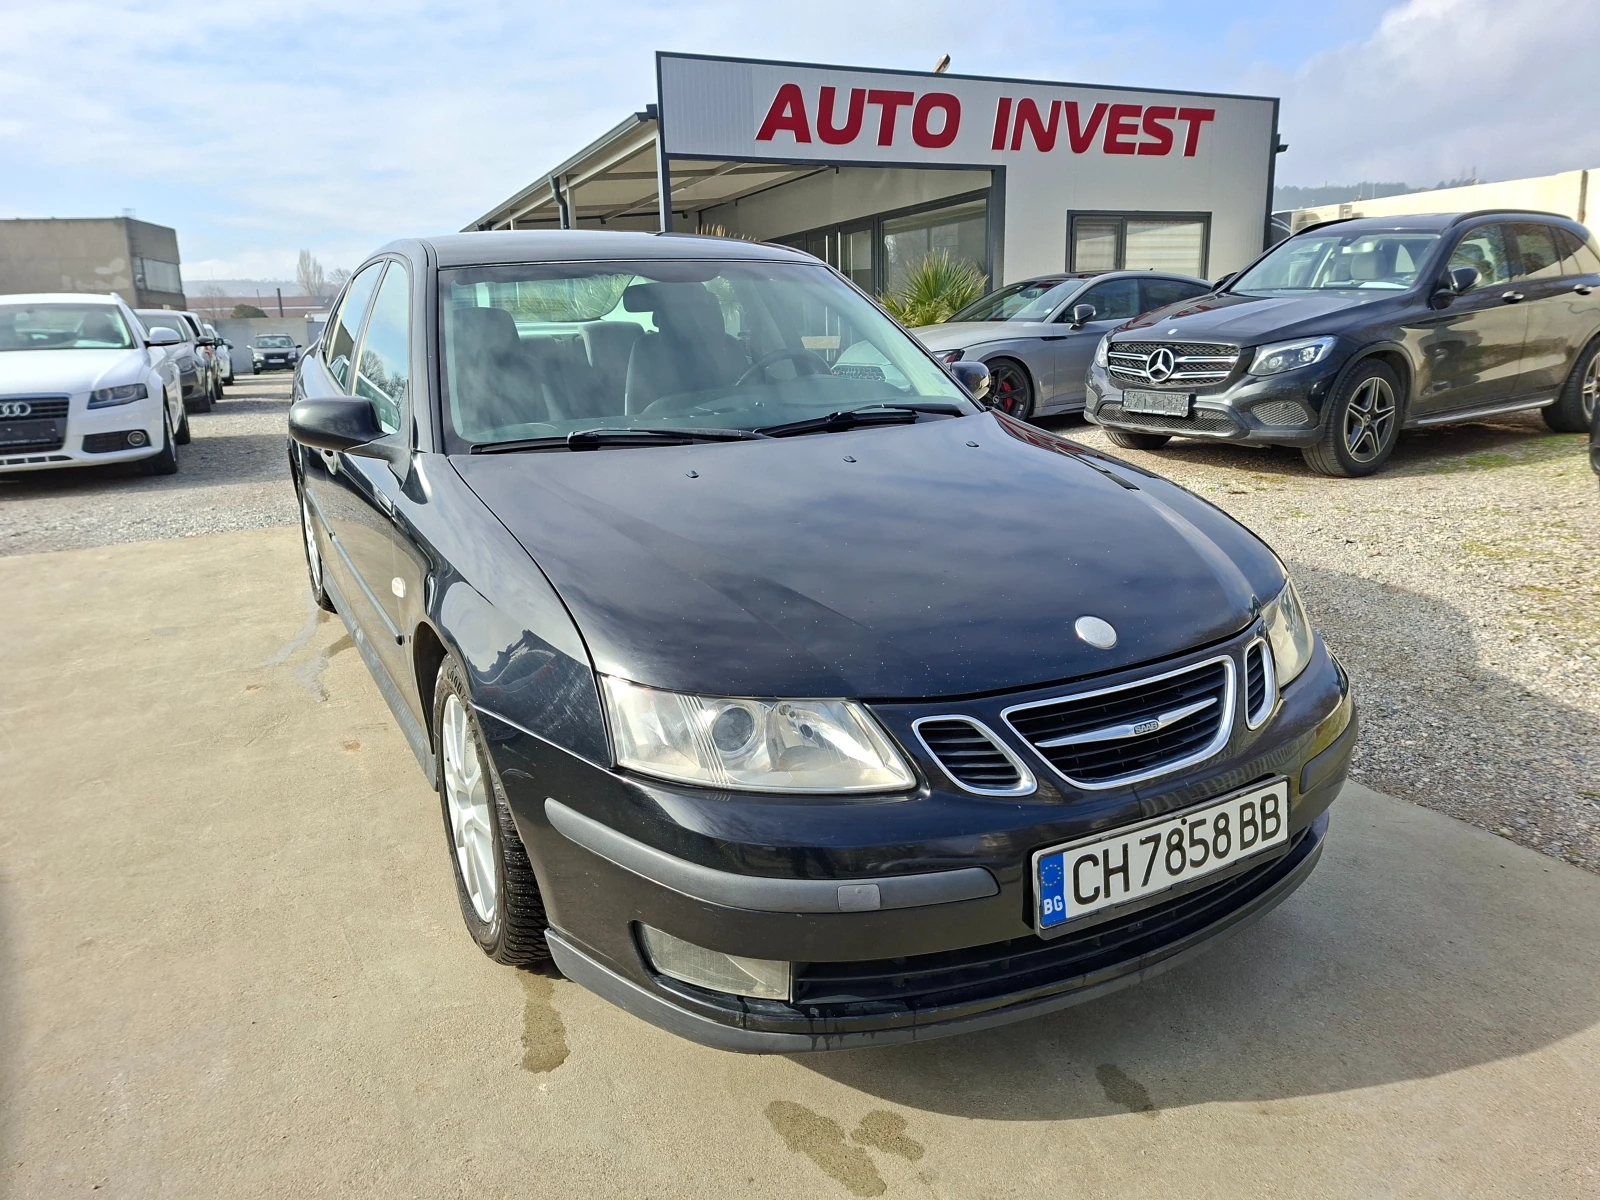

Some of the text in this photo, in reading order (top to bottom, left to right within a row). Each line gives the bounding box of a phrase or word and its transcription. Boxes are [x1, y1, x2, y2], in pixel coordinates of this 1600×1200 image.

[755, 83, 1215, 157] AUTO INVEST
[1134, 721, 1158, 734] SAAB
[1043, 895, 1064, 915] BG
